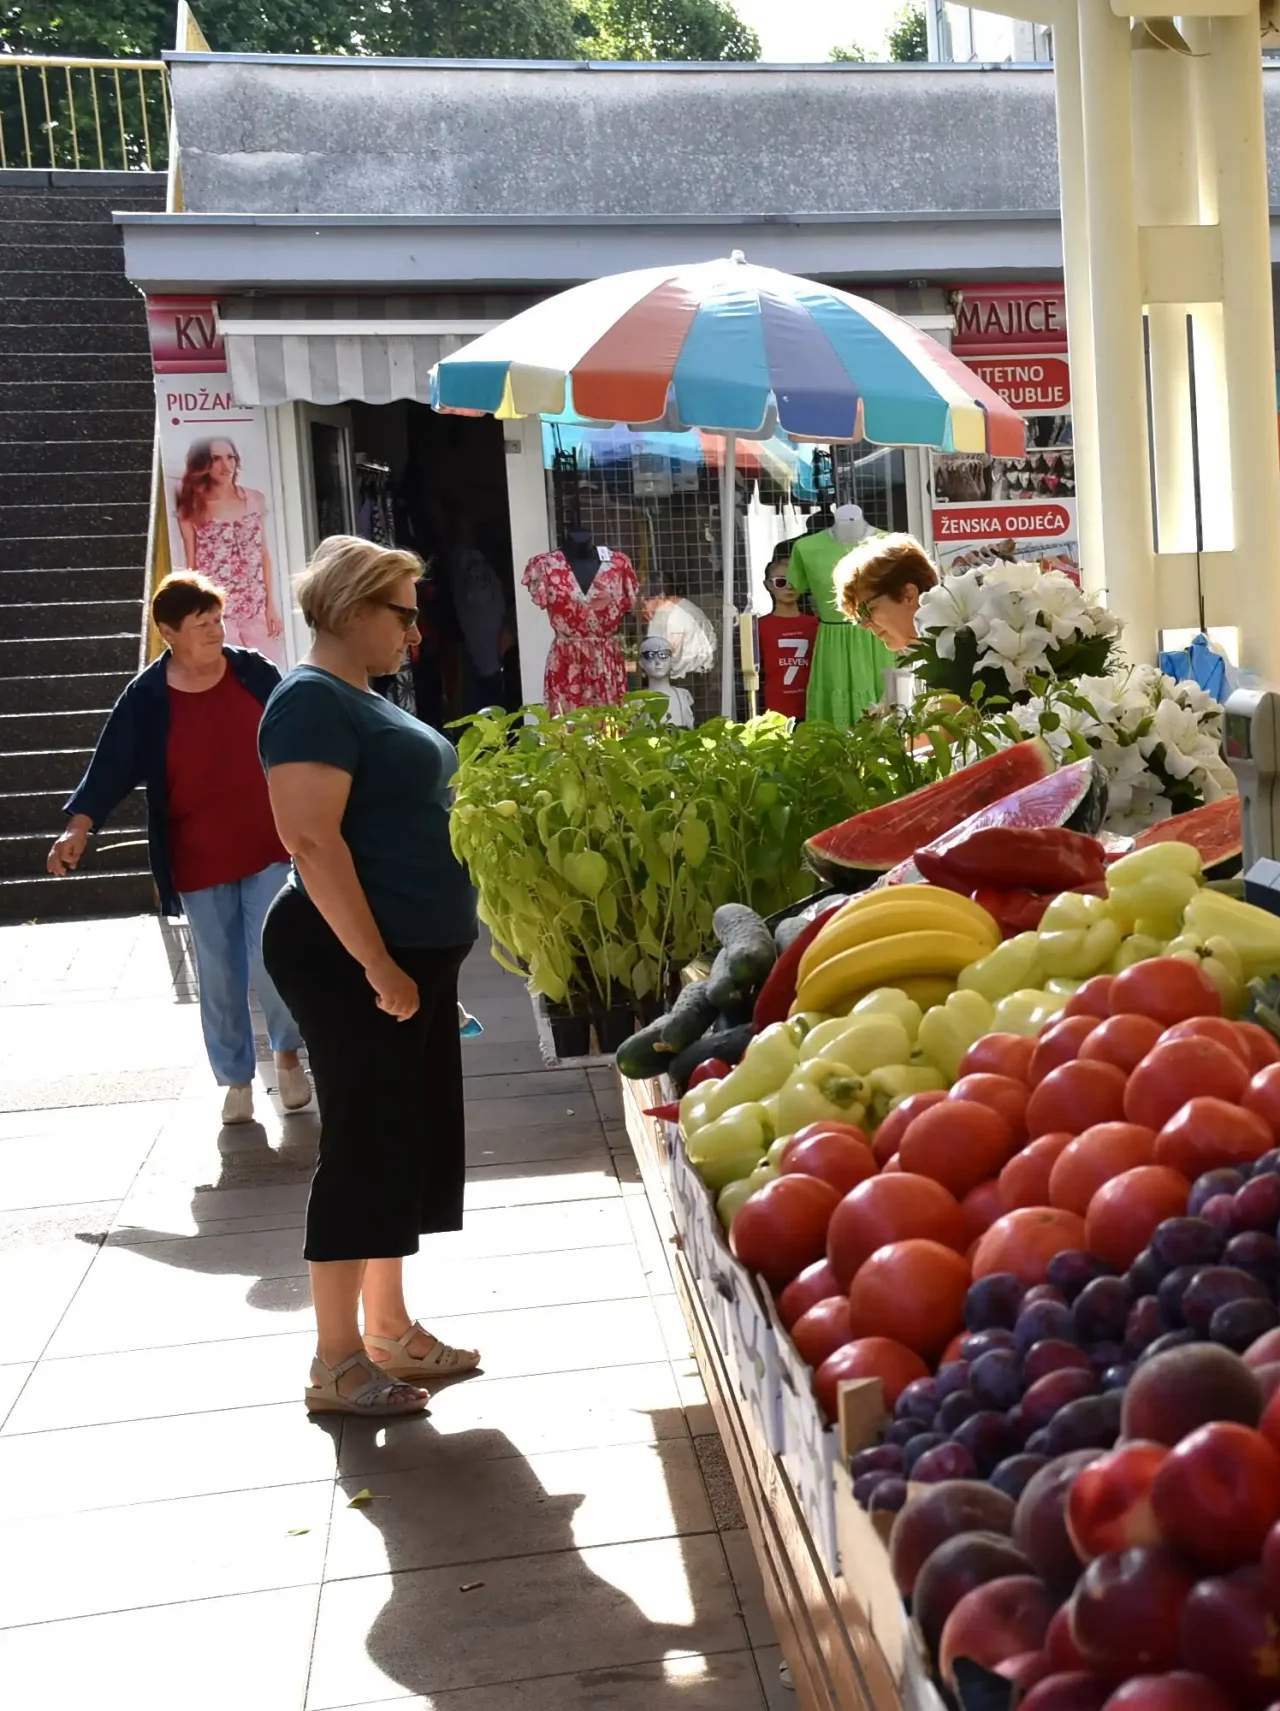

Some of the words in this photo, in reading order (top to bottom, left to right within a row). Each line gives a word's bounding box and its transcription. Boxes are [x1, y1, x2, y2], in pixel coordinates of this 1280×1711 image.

[958, 300, 1060, 336] MAJICE
[973, 365, 1045, 384] ITETNO
[166, 388, 255, 411] PIDŽA
[998, 386, 1065, 404] RUBLJE
[940, 516, 1001, 534] ŽENSKA
[1005, 511, 1065, 531] ODJEĆA
[778, 638, 809, 686] 7
[778, 657, 809, 667] ELEVEN
